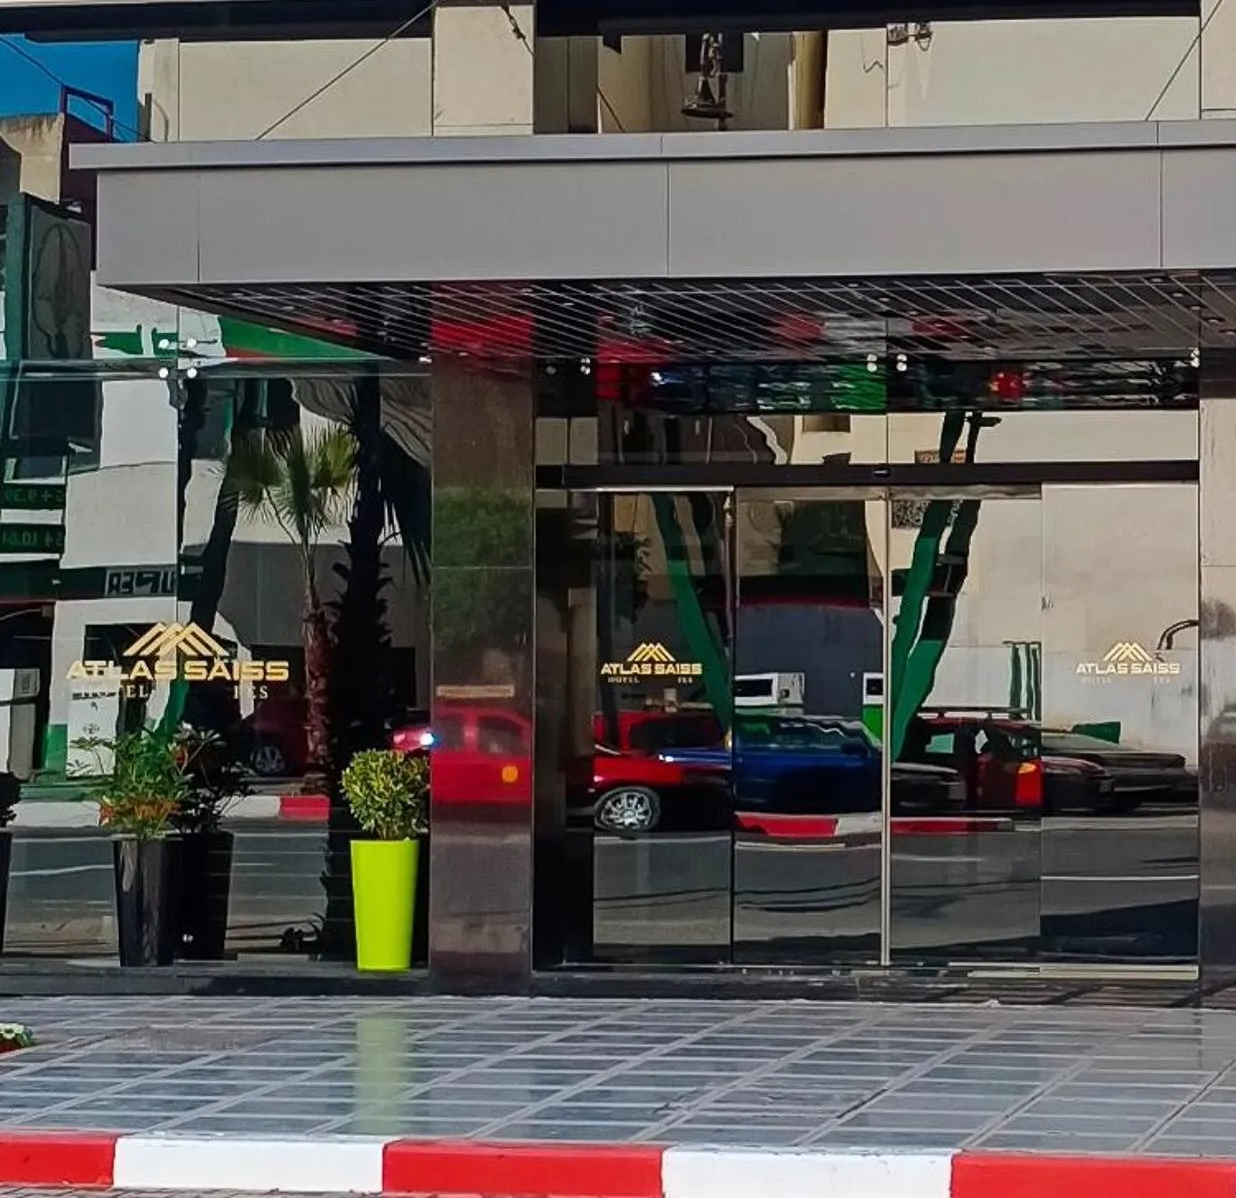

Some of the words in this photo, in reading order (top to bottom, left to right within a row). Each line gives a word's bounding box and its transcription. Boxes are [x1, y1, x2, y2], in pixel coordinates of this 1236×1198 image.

[66, 660, 177, 680] ATLAS
[184, 661, 289, 681] SAISS
[600, 663, 652, 675] ATLAS
[654, 663, 702, 675] SAISS
[1076, 663, 1128, 675] ATLAS
[1130, 663, 1180, 675] SAISS
